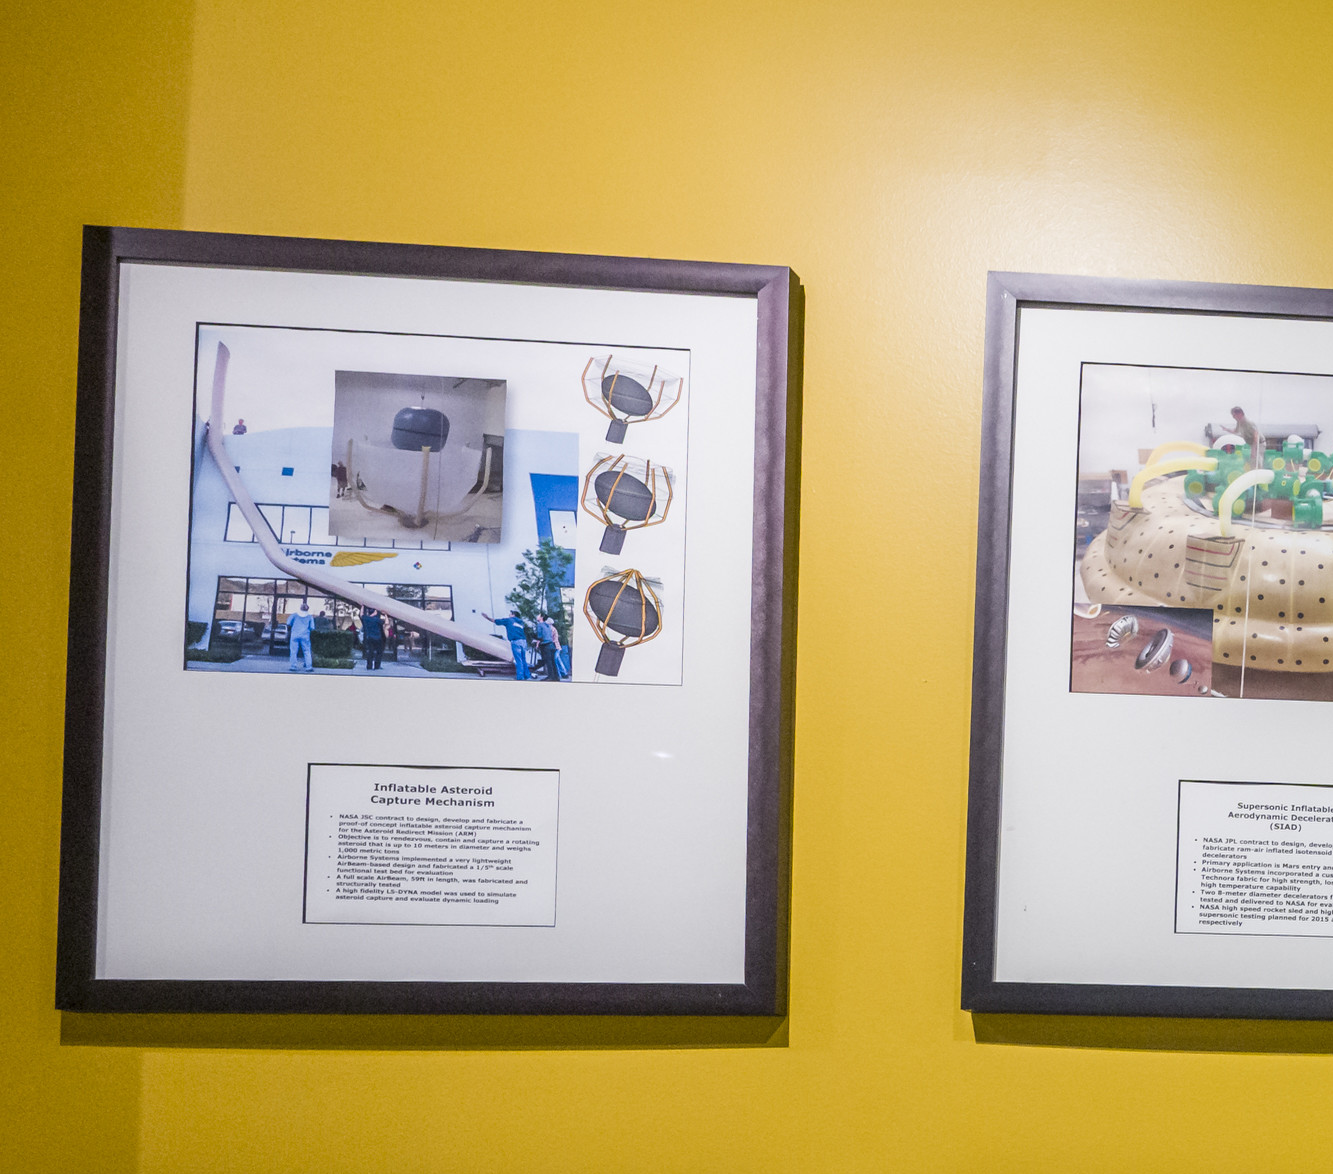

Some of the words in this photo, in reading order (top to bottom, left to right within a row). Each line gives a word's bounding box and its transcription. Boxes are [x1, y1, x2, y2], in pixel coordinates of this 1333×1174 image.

[374, 783, 436, 793] Inflatable
[440, 785, 493, 795] Asteroid
[370, 795, 421, 806] Capture
[425, 797, 495, 807] Mechanism
[1237, 802, 1288, 811] Supersonic
[1227, 811, 1288, 821] Aerodynamic
[1269, 822, 1302, 832] (SIAD)
